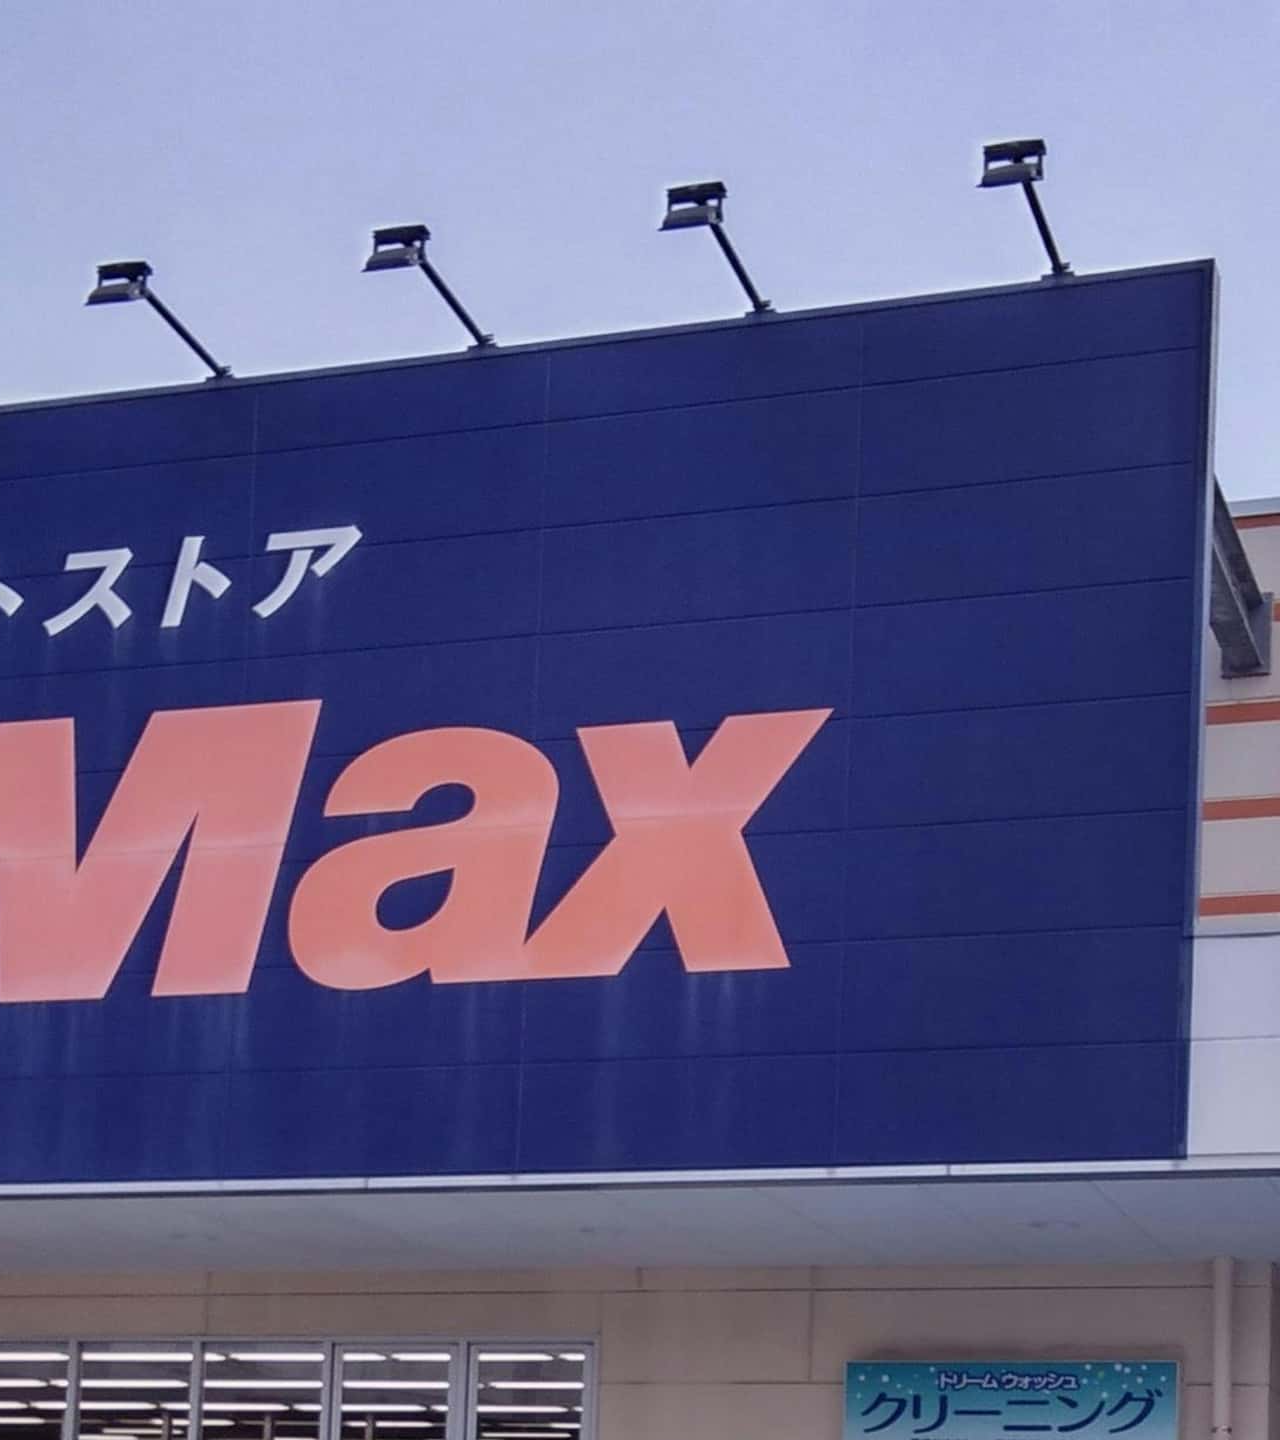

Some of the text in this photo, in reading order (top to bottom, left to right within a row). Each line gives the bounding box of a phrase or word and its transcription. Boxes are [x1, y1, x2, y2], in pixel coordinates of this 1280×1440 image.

[938, 1370, 1079, 1391] ドリーム ウォッシュ
[861, 1388, 1163, 1435] クリーニング
